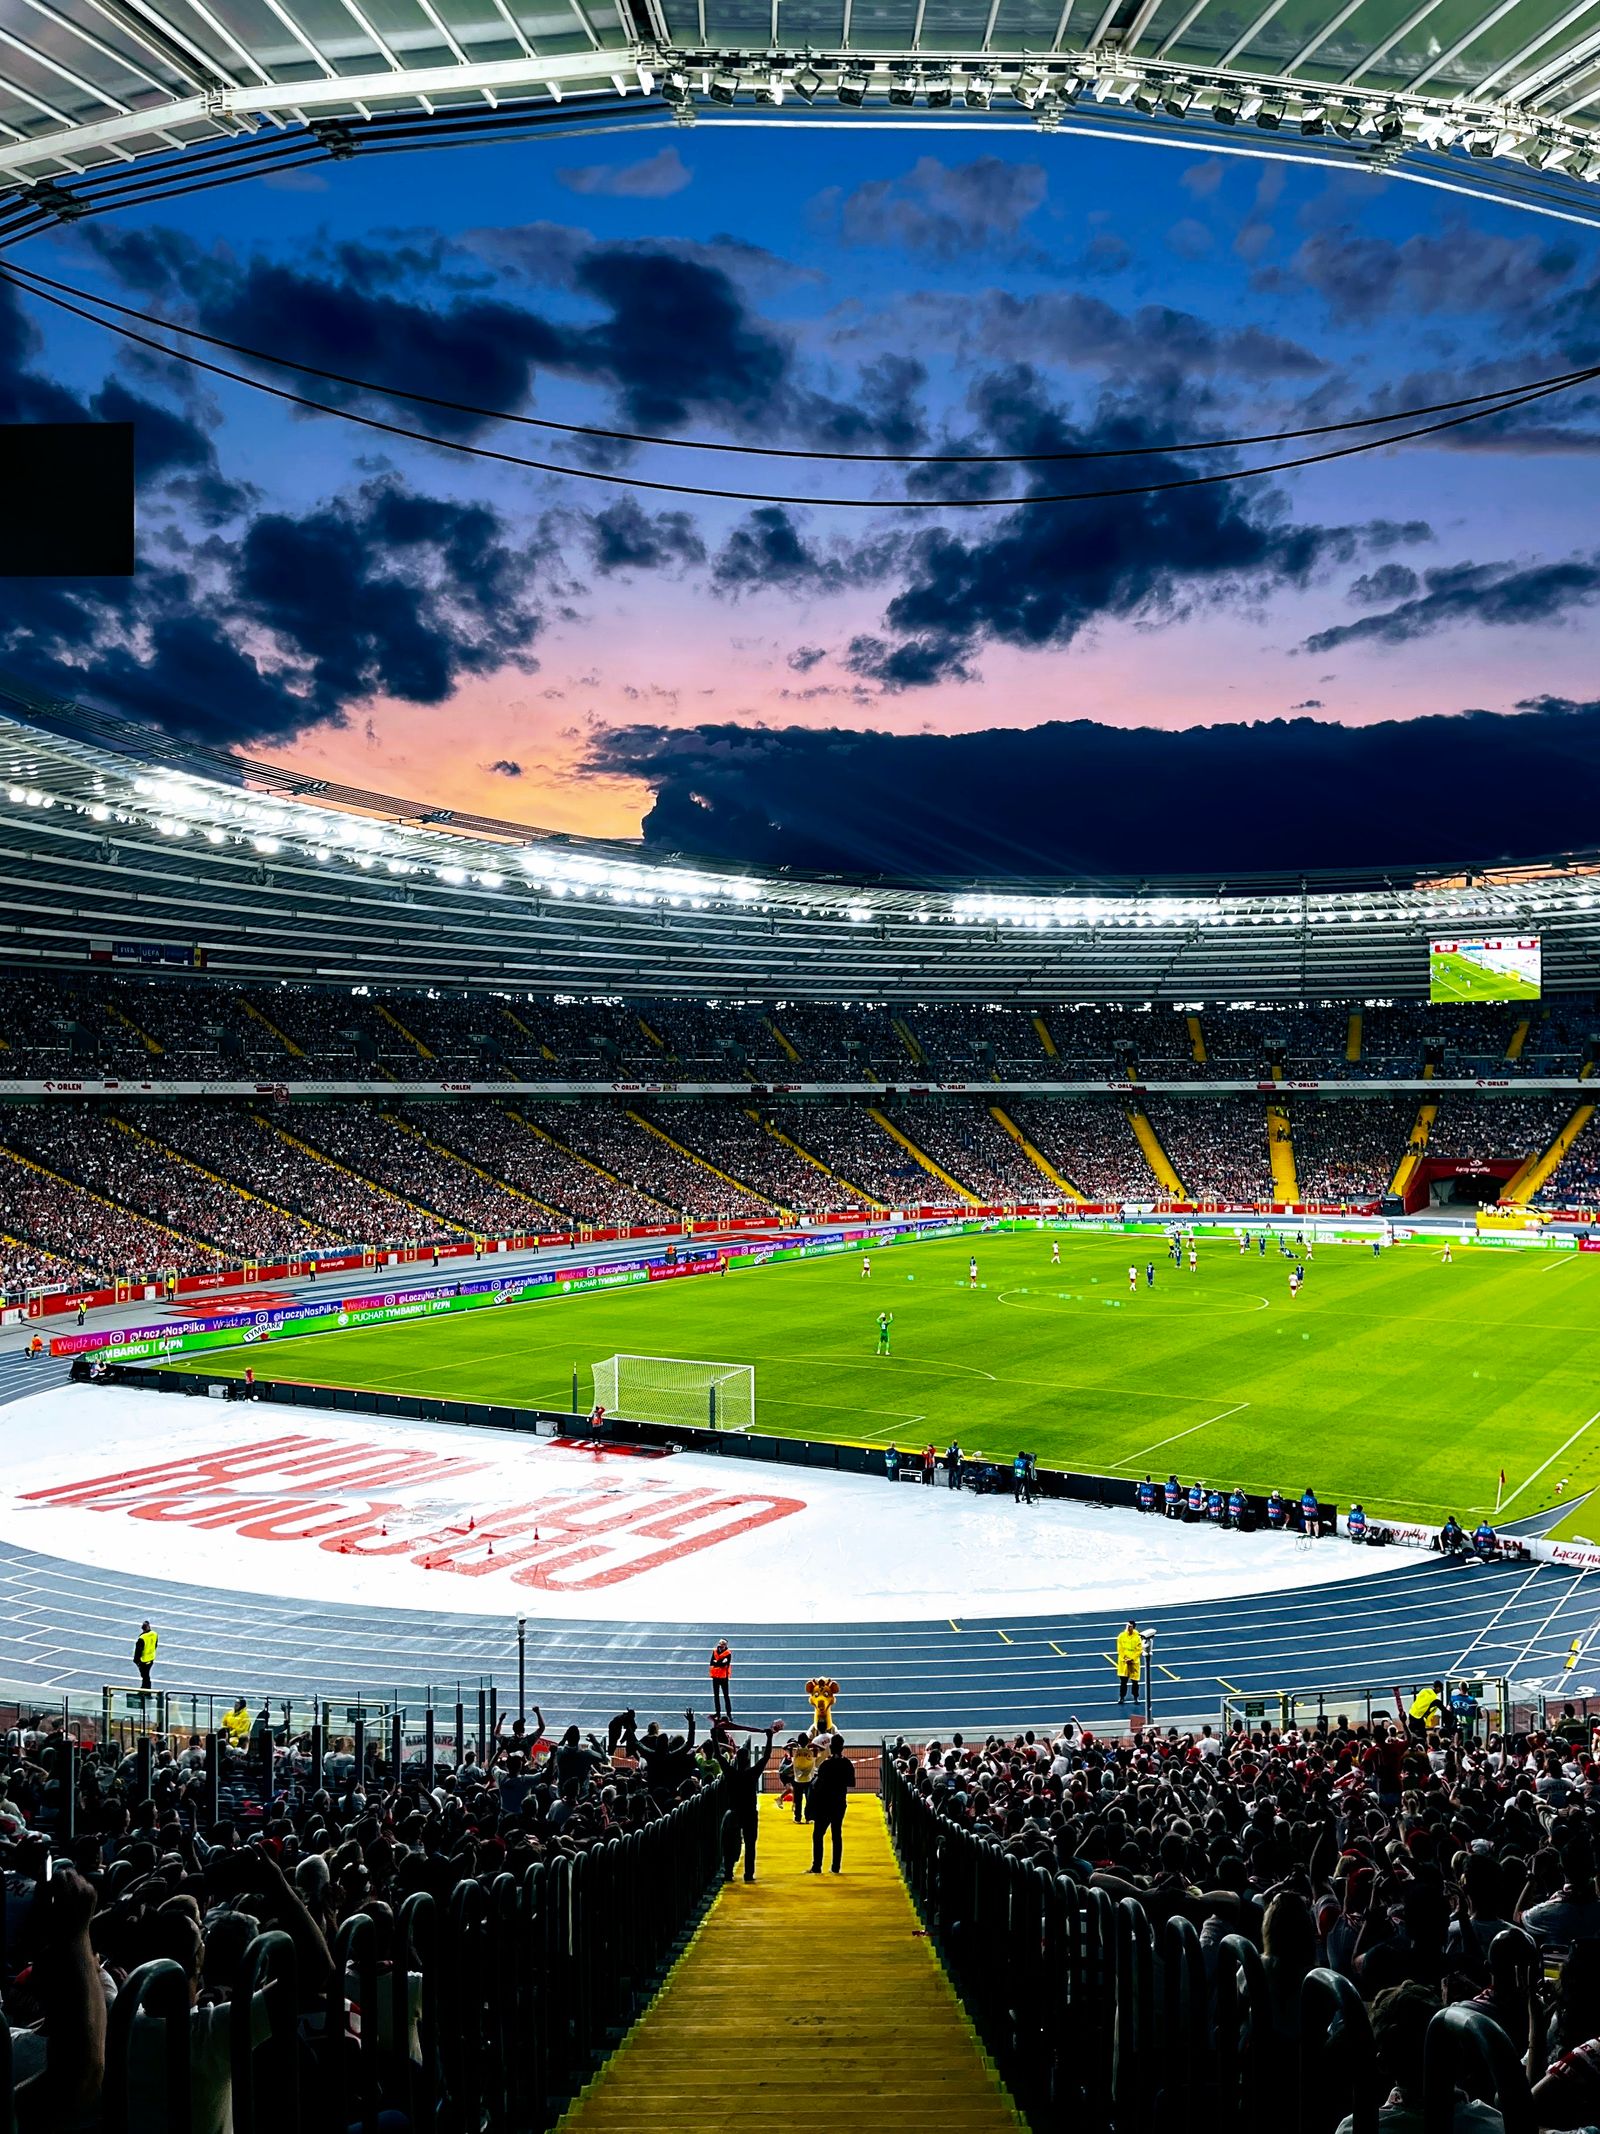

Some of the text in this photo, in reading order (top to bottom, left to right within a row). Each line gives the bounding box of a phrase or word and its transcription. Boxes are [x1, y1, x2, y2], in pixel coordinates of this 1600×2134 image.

[1473, 1238, 1505, 1246] PUCHAR
[479, 1284, 488, 1292] na
[573, 1270, 647, 1289] PUCHAR TYMBARKU PZPN
[347, 1289, 455, 1311] Wejdź na @LaczyNaPilka
[352, 1300, 451, 1322] PUCHAR TYMBARKU PZPN
[246, 1321, 283, 1340] TYMBARK
[57, 1336, 89, 1352] Wejdź
[90, 1336, 103, 1347] na
[1400, 1527, 1428, 1542] piłka
[1495, 1539, 1523, 1551] LEN
[1552, 1546, 1586, 1565] Łączy
